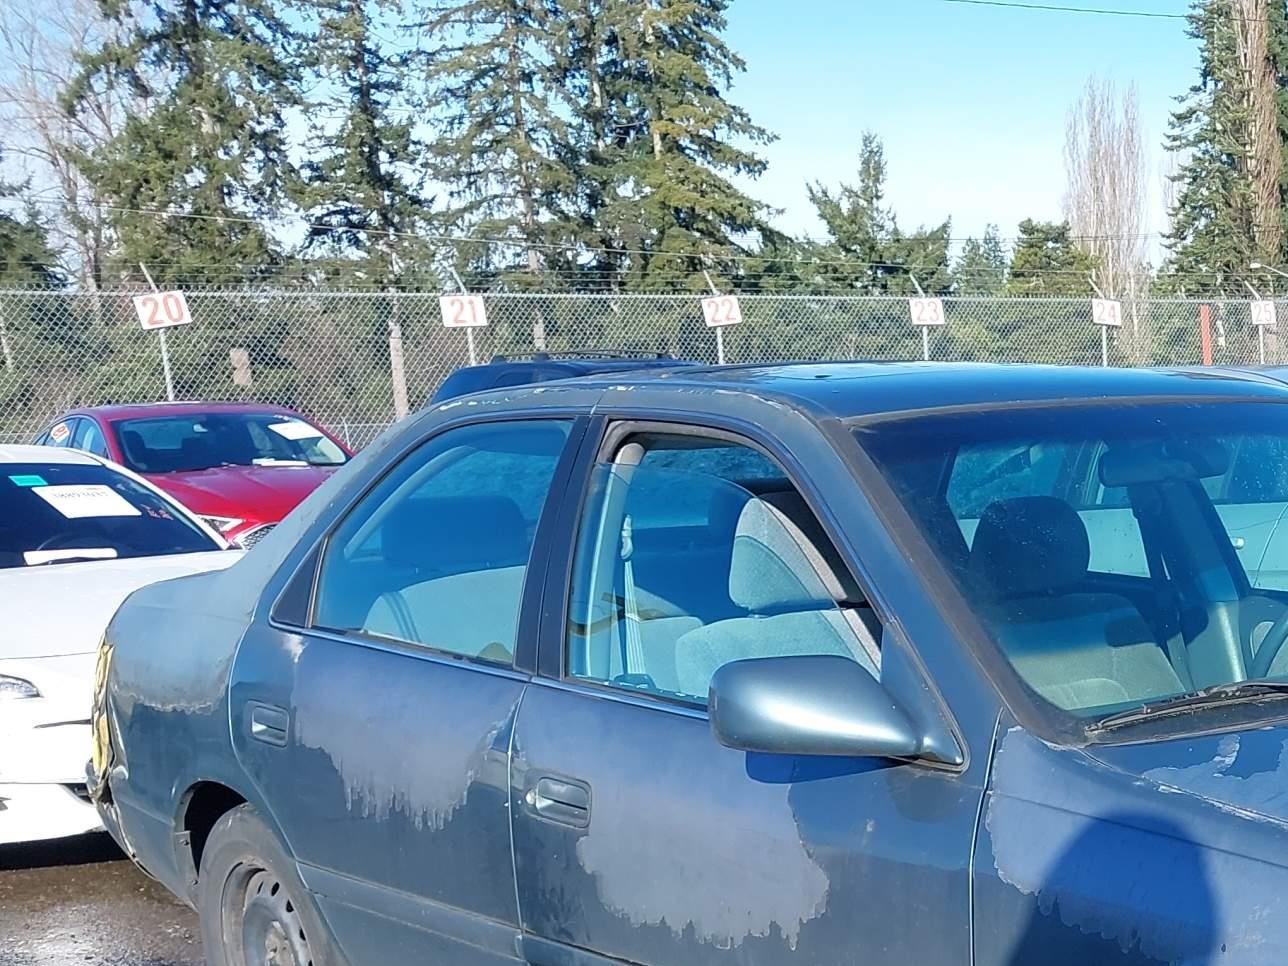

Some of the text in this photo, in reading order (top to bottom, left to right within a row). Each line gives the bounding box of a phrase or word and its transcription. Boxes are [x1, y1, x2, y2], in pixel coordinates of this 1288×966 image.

[141, 293, 186, 325] 20
[451, 299, 478, 322] 21
[708, 299, 737, 323] 22
[914, 301, 939, 322] 23
[1097, 302, 1117, 323] 24
[1255, 302, 1273, 323] 25
